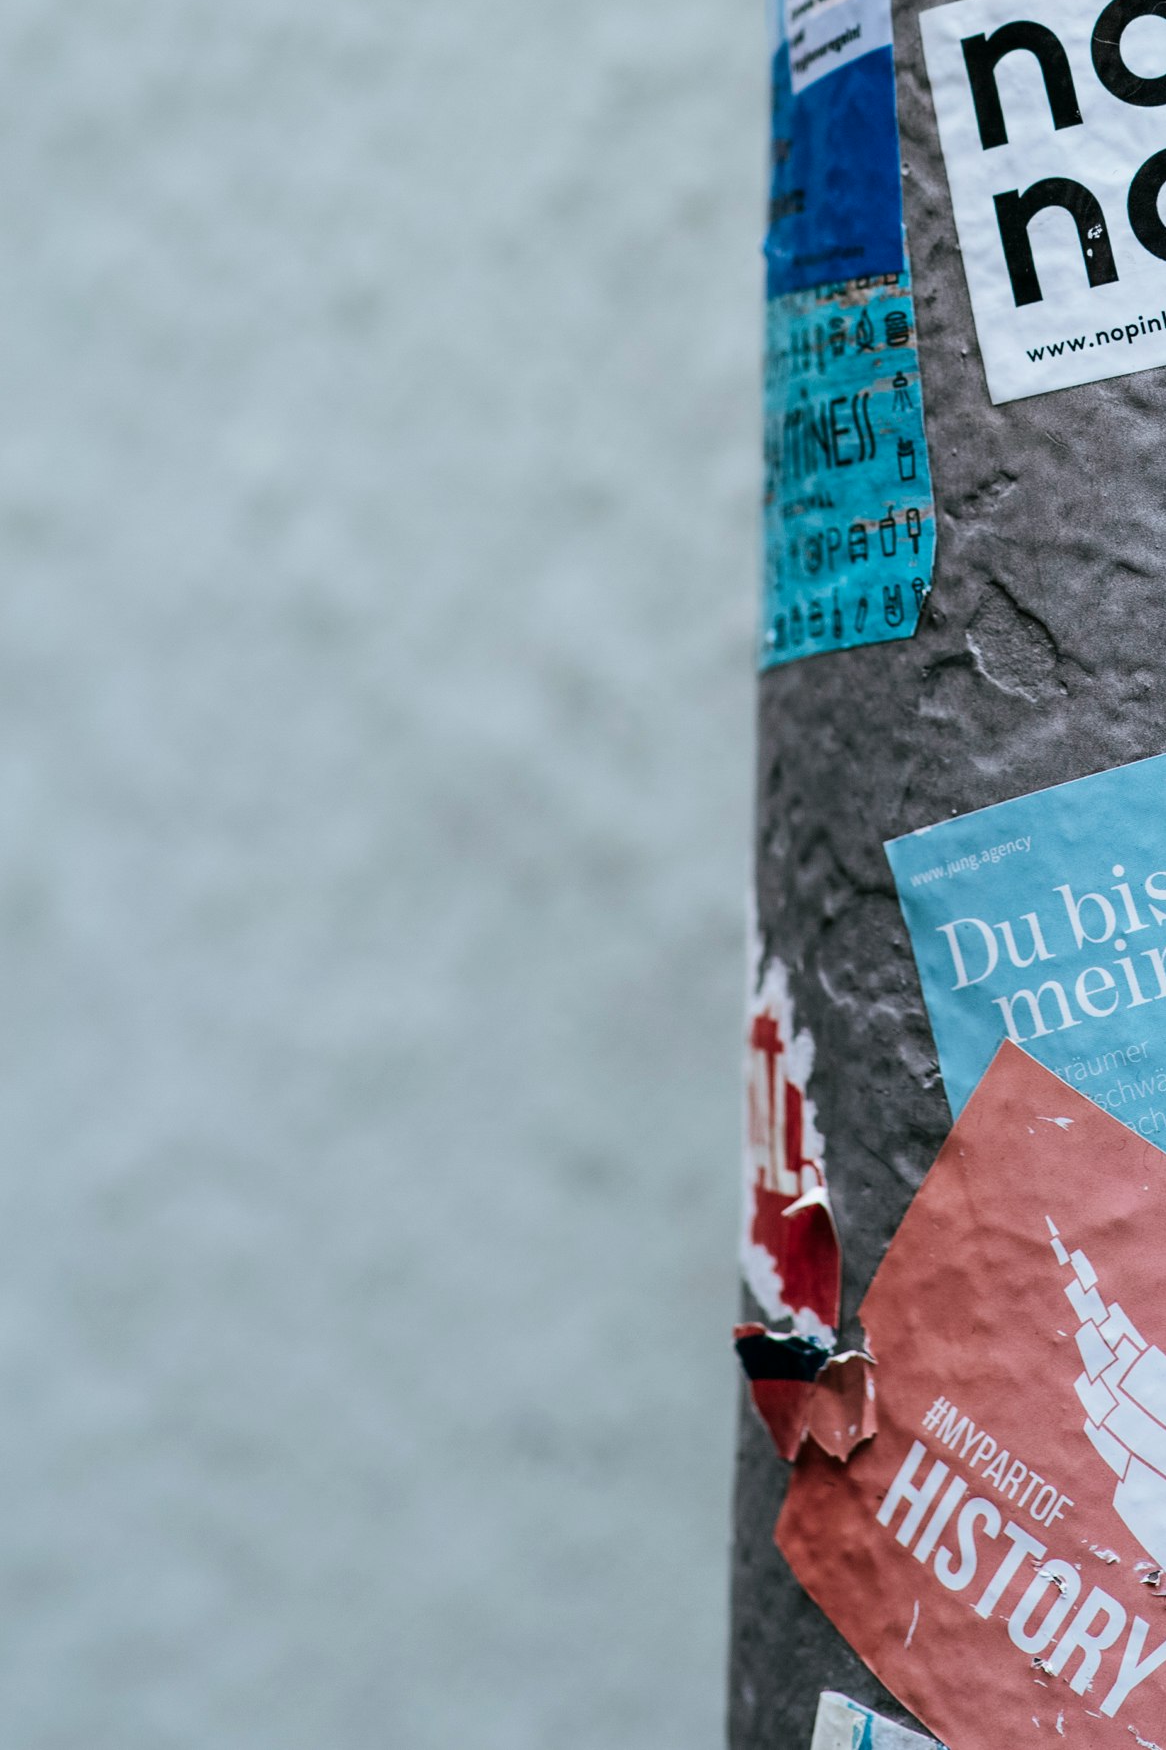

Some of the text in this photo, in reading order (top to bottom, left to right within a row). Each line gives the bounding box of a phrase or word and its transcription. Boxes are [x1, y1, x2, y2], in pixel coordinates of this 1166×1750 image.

[909, 835, 1033, 889] www.jung.agency
[936, 911, 1056, 991] Du
[921, 1395, 1075, 1528] #MYPARTOF
